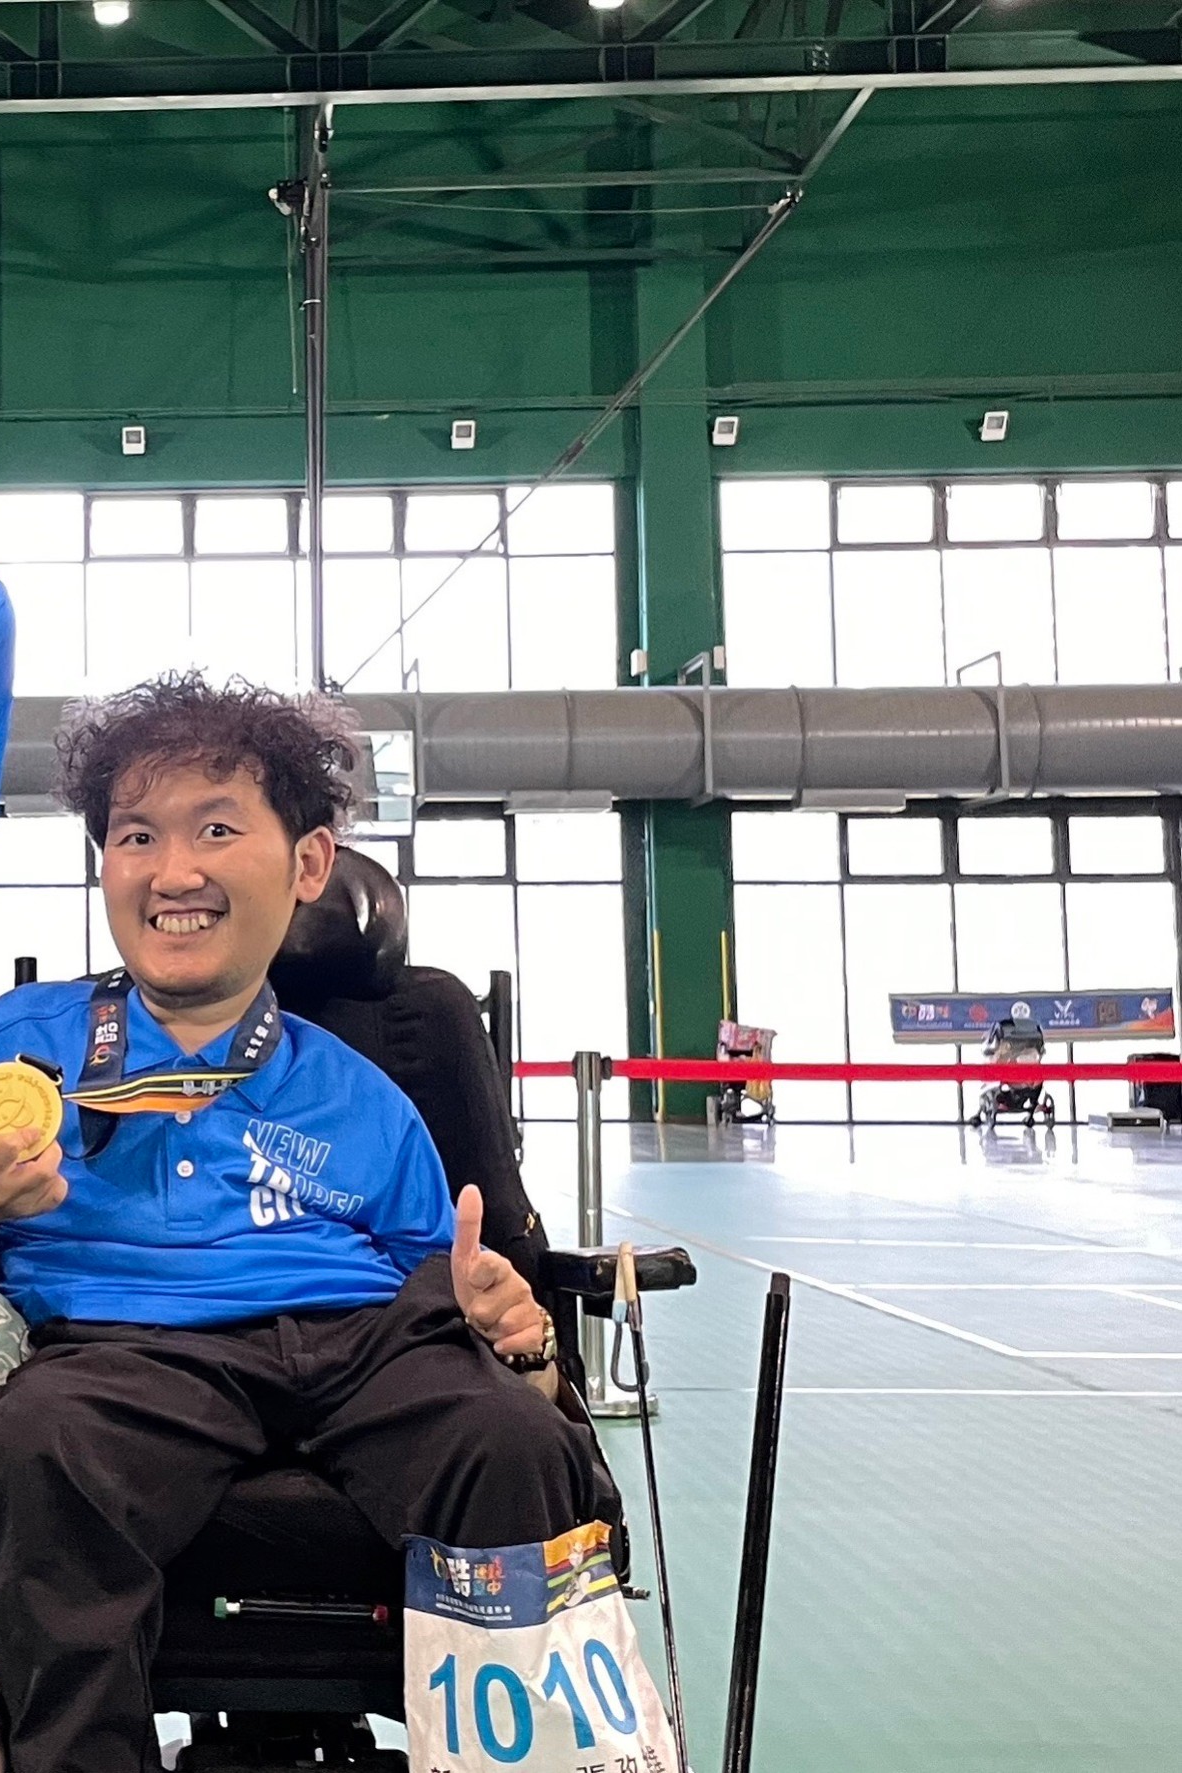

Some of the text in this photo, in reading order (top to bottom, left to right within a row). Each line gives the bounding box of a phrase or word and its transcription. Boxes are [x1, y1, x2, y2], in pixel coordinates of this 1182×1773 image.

[242, 1118, 331, 1176] NEW
[246, 1152, 364, 1219] TAIPEI
[249, 1185, 306, 1227] CIT
[429, 1638, 637, 1764] 1010
